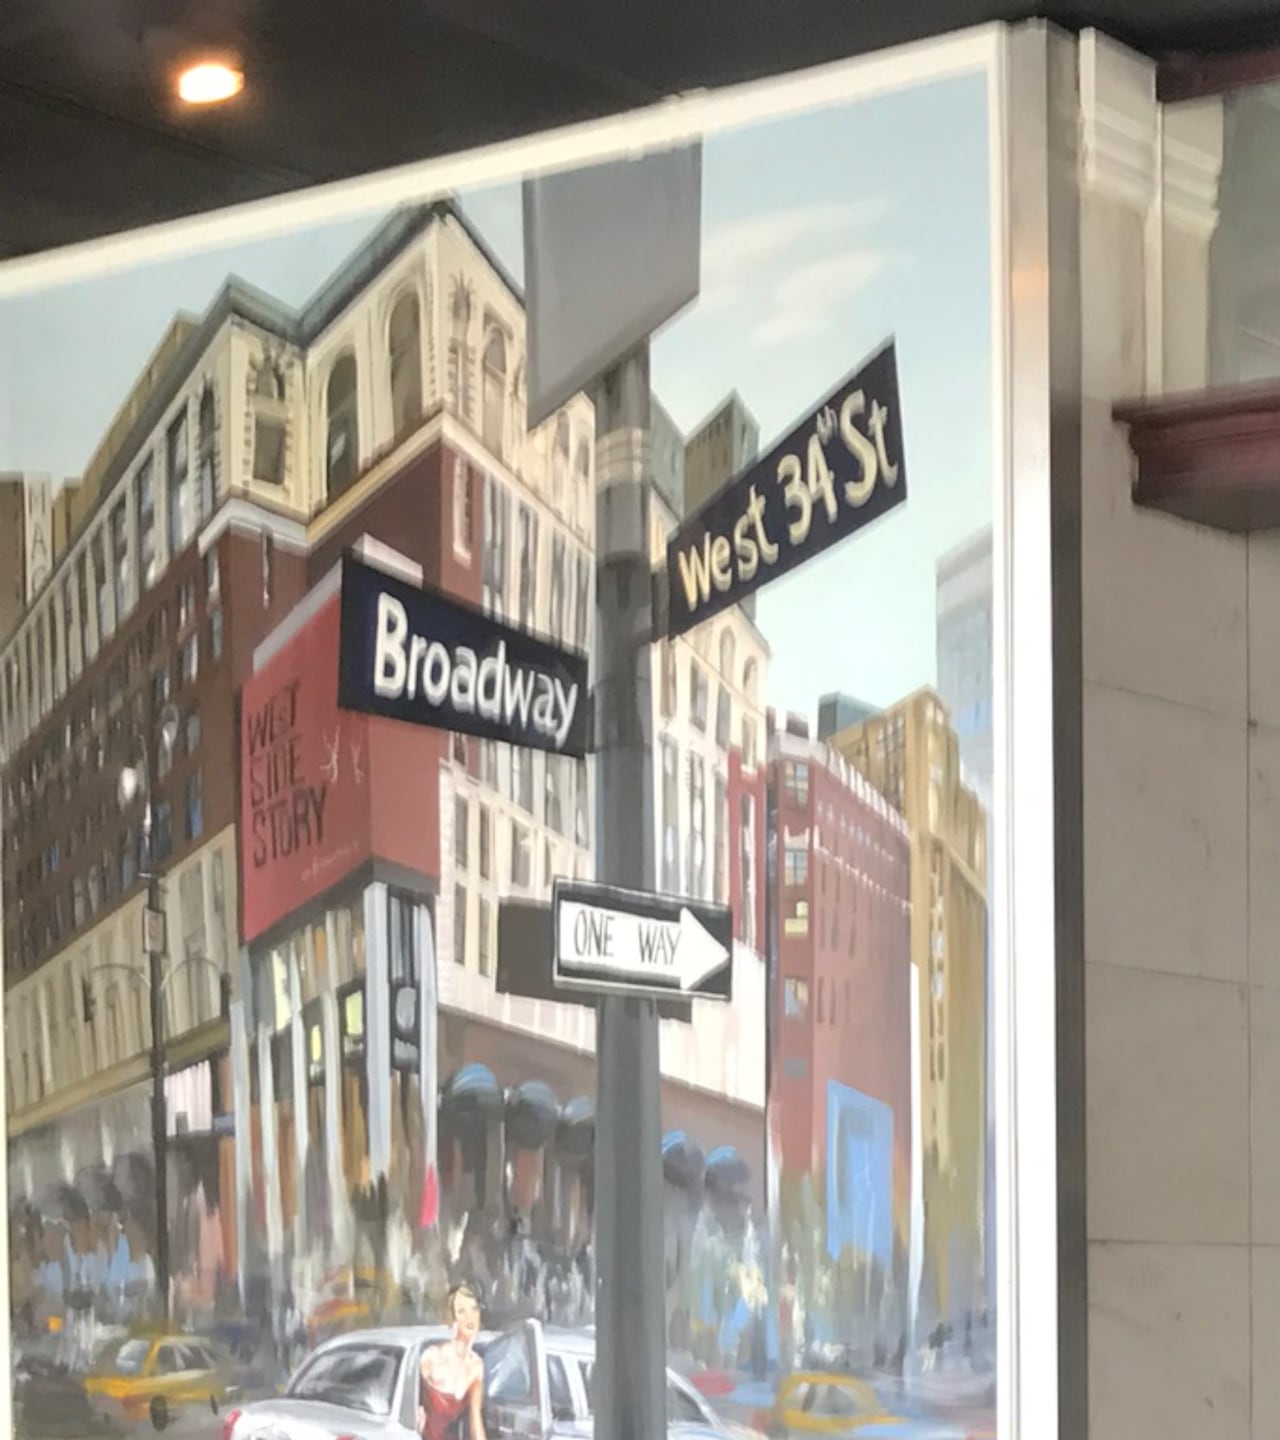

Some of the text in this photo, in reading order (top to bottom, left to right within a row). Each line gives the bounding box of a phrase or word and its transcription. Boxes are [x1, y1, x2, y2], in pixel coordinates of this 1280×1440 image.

[677, 483, 779, 612] West
[839, 388, 899, 504] St
[373, 591, 578, 750] Broadway
[248, 680, 299, 752] WEST
[250, 733, 305, 806] SIDE
[252, 785, 328, 869] STORY
[573, 908, 683, 967] ONE WAY
